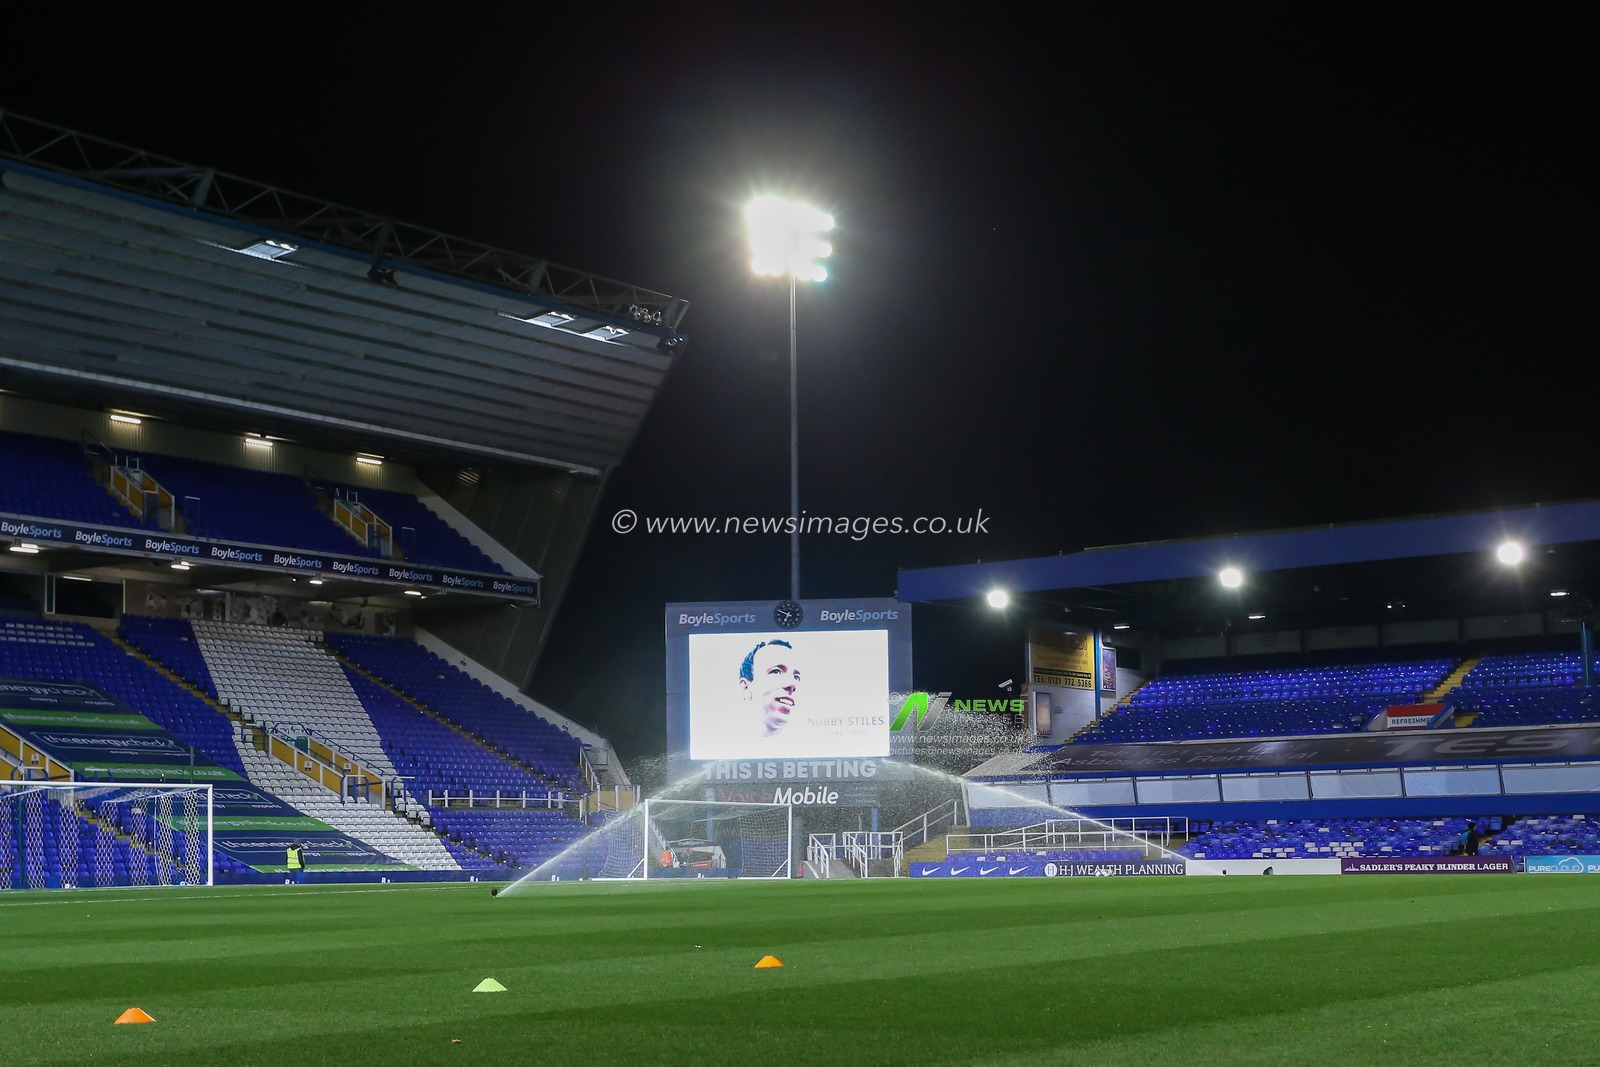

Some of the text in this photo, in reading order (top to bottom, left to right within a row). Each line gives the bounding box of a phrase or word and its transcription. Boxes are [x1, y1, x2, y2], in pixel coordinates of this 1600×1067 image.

[1, 521, 62, 539] BoyleSports
[75, 531, 132, 547] BoyleSports
[145, 539, 200, 554] BoyleSports
[211, 546, 262, 562] BoyleSports
[273, 554, 322, 569] BoyleSports
[333, 561, 379, 575] BoyleSports
[389, 568, 433, 582] BoyleSports
[442, 574, 484, 588] BoyleSports
[493, 580, 533, 594] BoyleSports
[678, 612, 756, 626] BoyleSports
[820, 609, 898, 622] BoyleSports
[807, 716, 885, 726] NOBBY STILES
[703, 760, 877, 780] THIS IS BETTING
[773, 786, 839, 805] Mobile
[1076, 864, 1122, 875] WEALTH
[1125, 863, 1184, 875] PLANNING
[1359, 863, 1403, 871] SADLER'S
[1404, 863, 1435, 871] PEAKY
[1436, 863, 1476, 871] BLINDER
[1528, 864, 1580, 872] PURECLOUD
